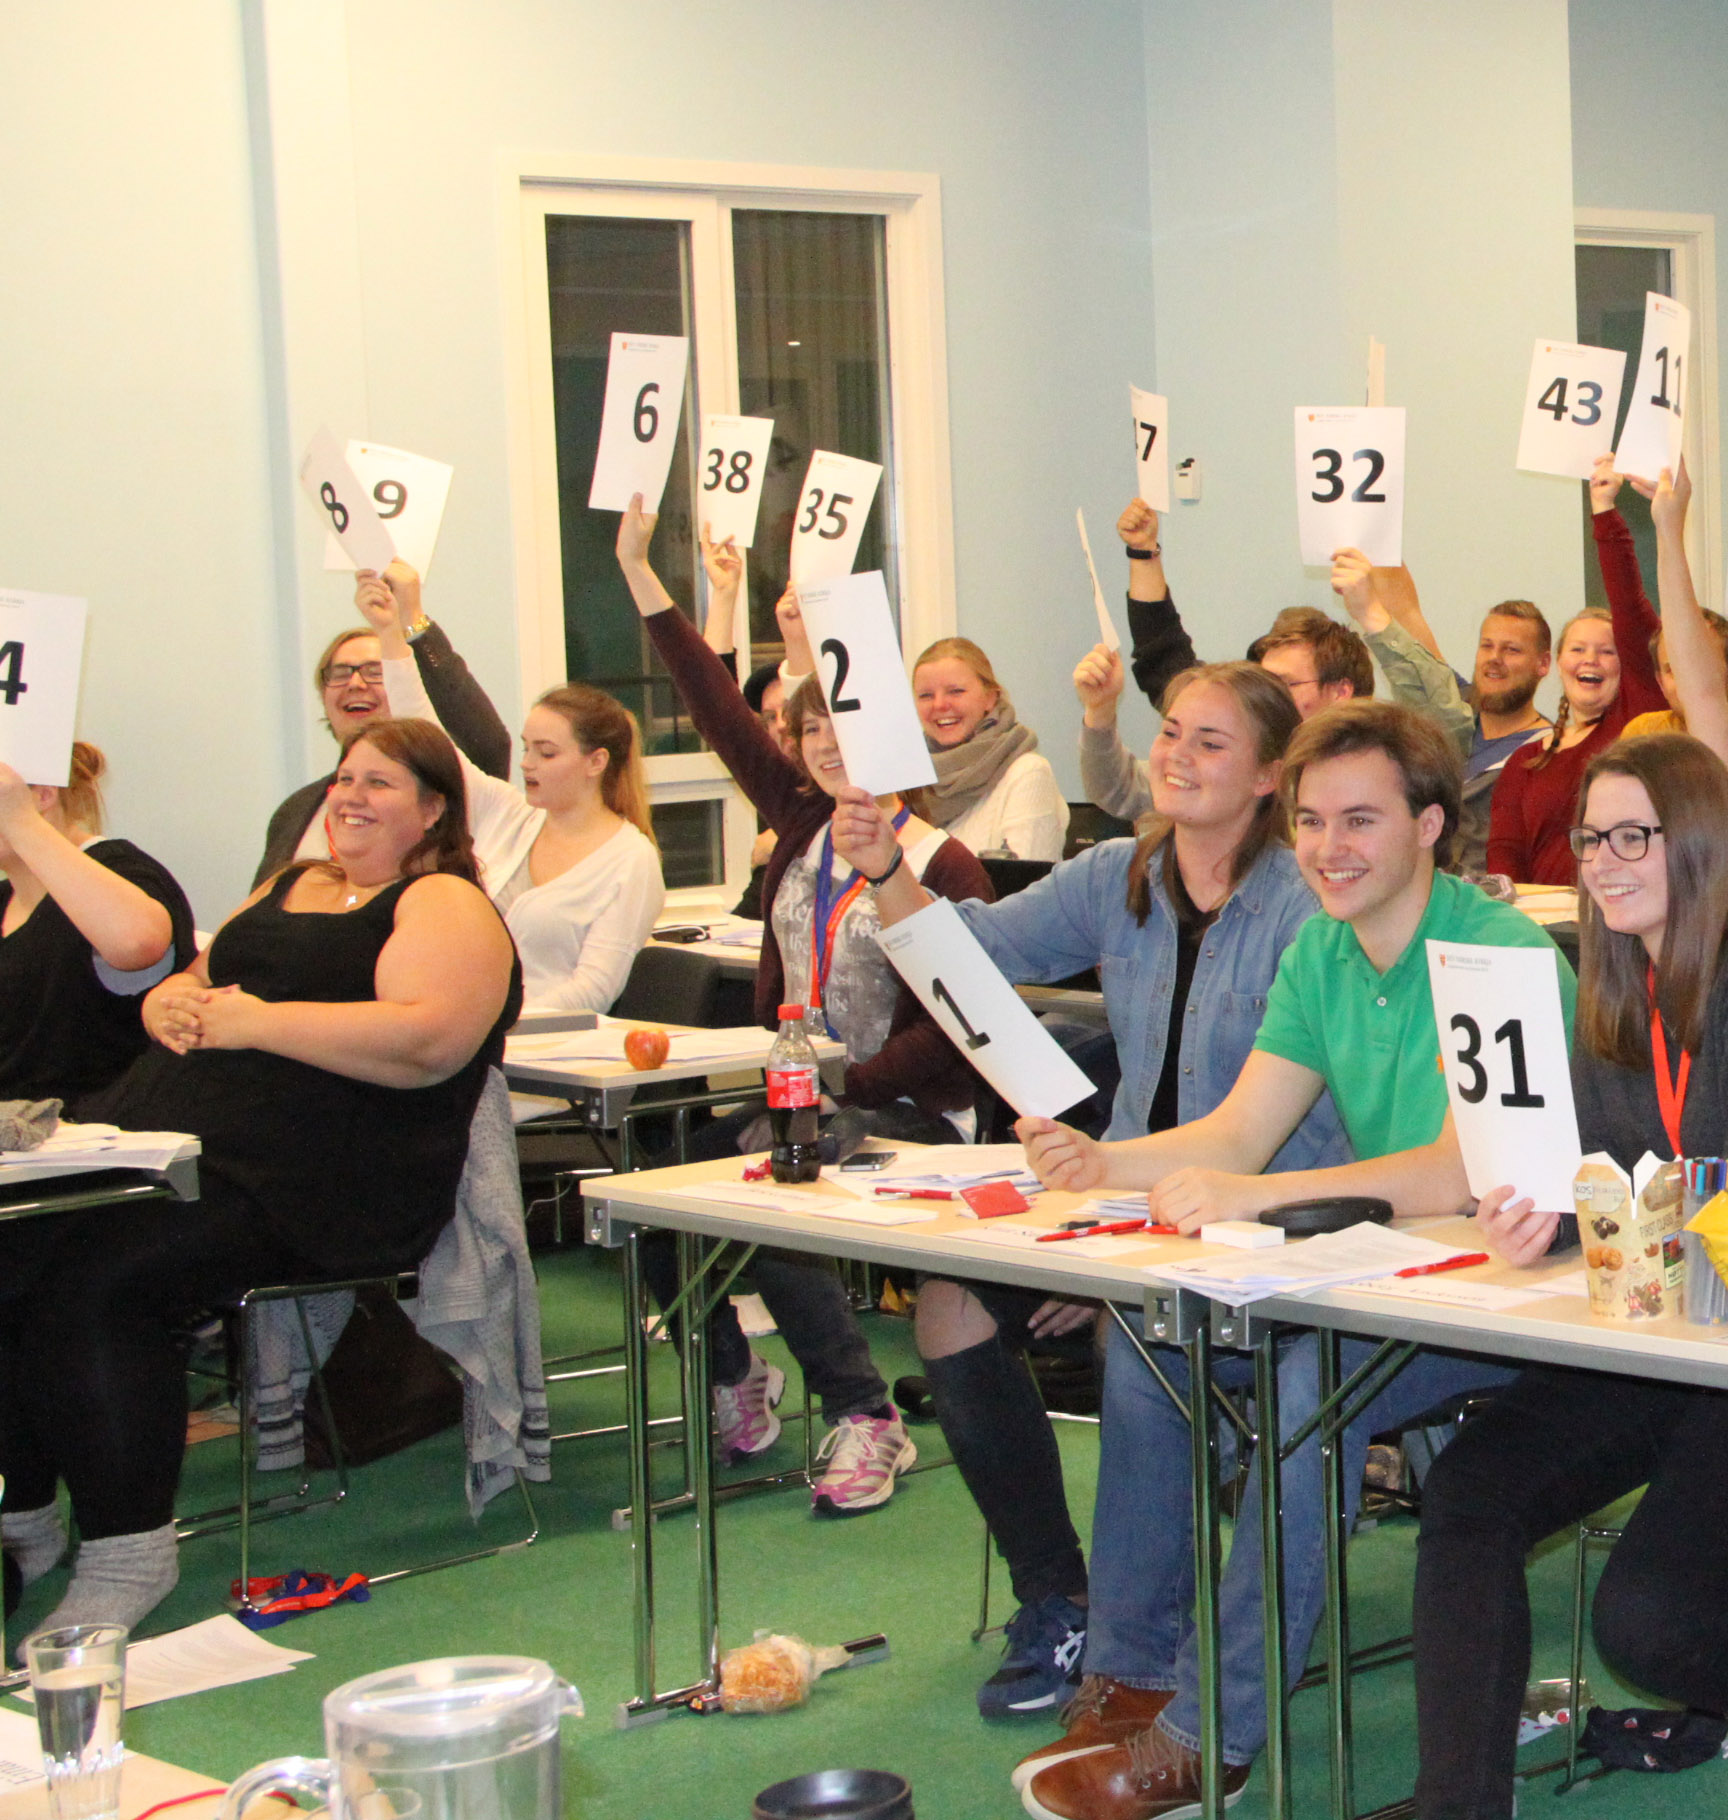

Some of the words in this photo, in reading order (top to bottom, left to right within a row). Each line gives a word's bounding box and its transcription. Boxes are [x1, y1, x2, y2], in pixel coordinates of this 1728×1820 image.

[633, 382, 661, 444] 6
[1537, 376, 1603, 427] 43
[1133, 417, 1158, 462] 7
[703, 448, 753, 494] 38
[1311, 447, 1387, 504] 32
[319, 481, 349, 534] 8
[372, 479, 408, 520] 9
[799, 487, 853, 540] 35
[820, 637, 862, 713] 2
[932, 977, 992, 1051] 1
[1449, 1012, 1546, 1109] 31
